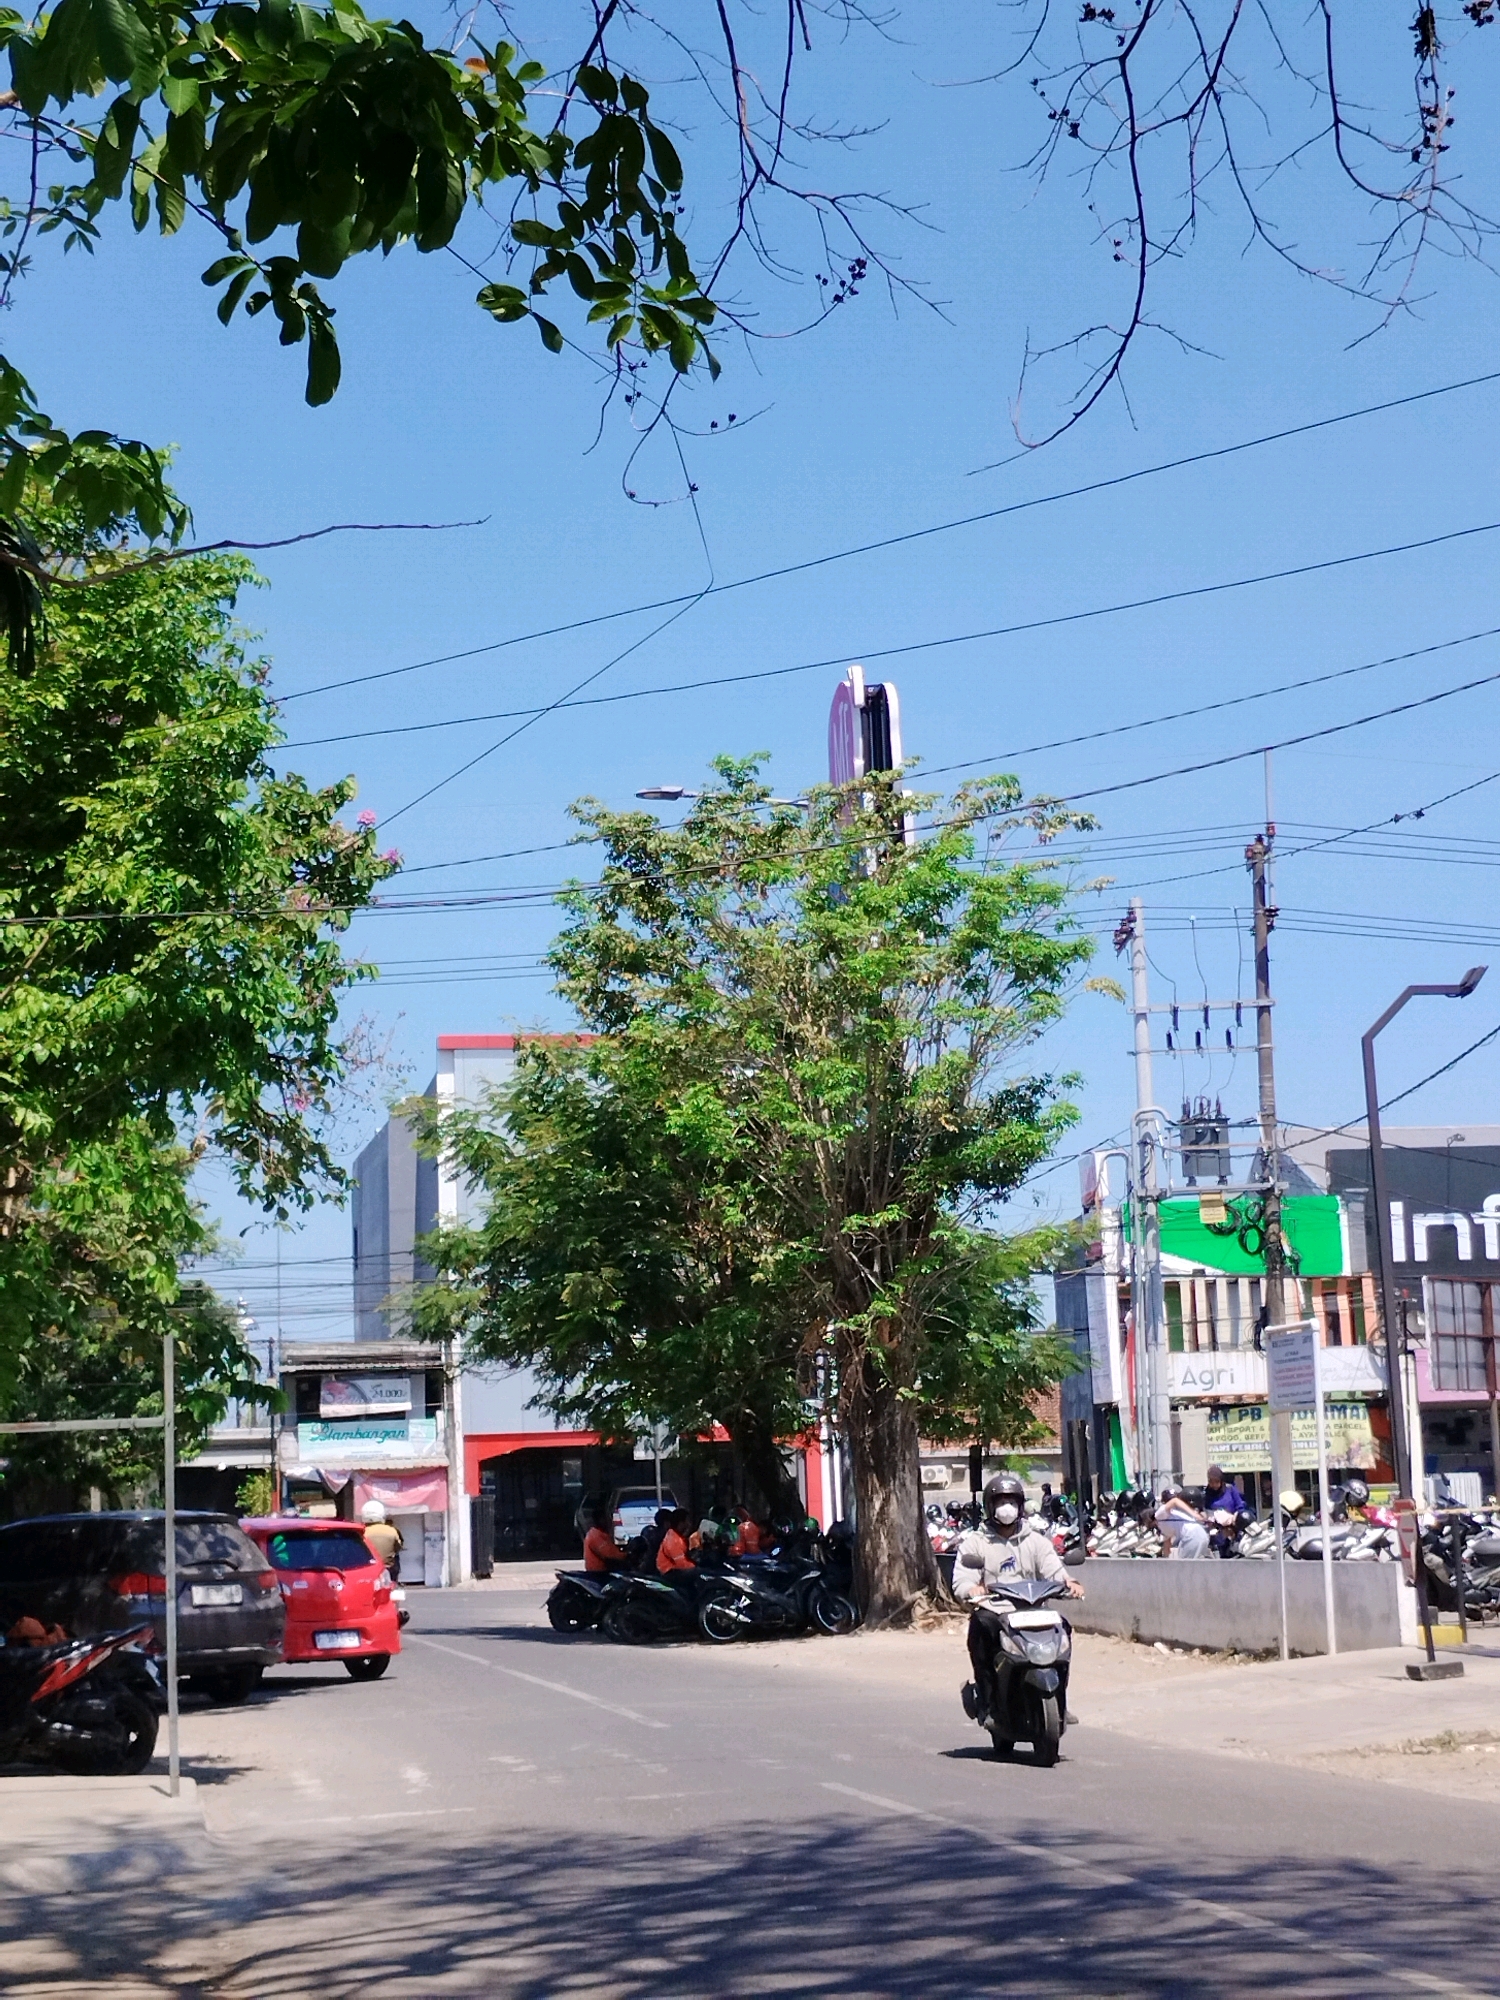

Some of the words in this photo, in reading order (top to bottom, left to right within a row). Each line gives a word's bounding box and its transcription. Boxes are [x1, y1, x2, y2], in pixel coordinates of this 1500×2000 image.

[1181, 1366, 1235, 1391] Agri
[1238, 1407, 1262, 1422] PB
[309, 1422, 406, 1444] Blambangan
